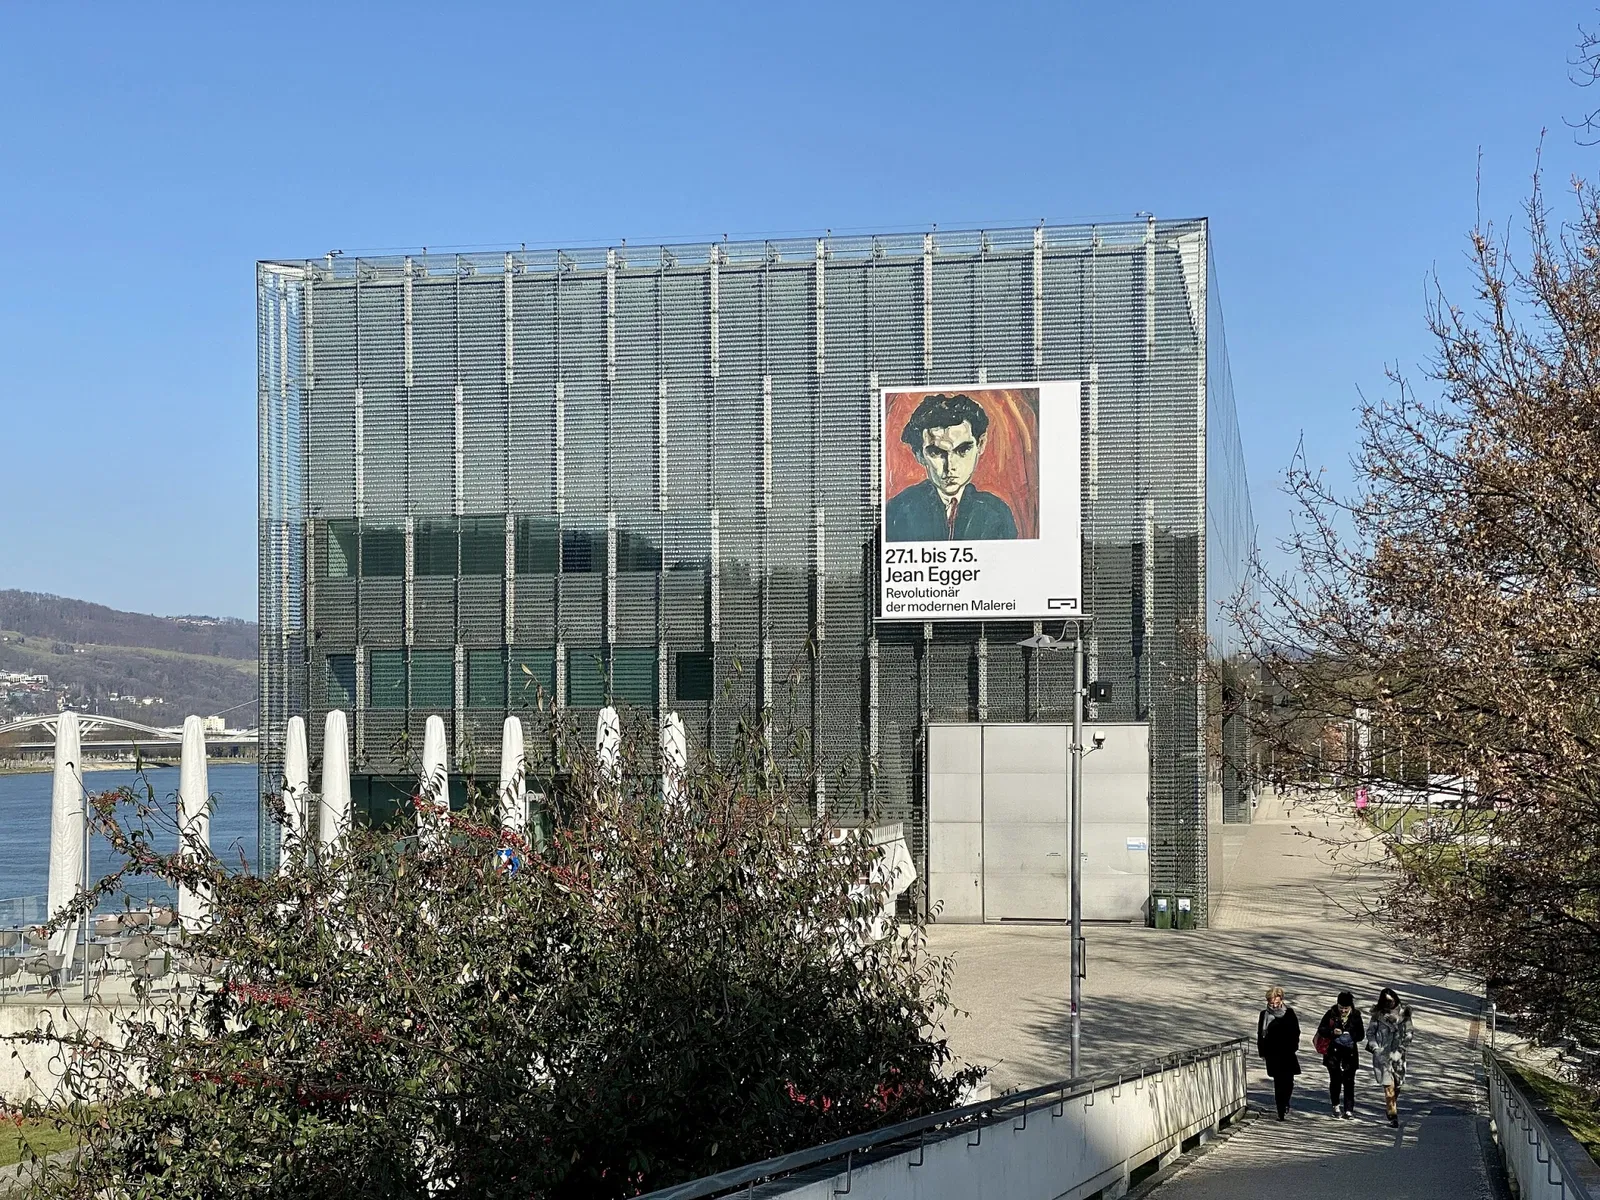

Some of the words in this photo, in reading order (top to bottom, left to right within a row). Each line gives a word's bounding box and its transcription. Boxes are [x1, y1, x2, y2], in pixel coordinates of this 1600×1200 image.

[885, 548, 918, 564] 27.1.
[921, 547, 947, 563] bis
[949, 547, 978, 563] 7.5.
[885, 567, 924, 583] Jean
[928, 566, 980, 585] Egger
[886, 587, 961, 599] Revolutionär
[886, 601, 906, 613] der
[907, 602, 969, 612] modernen
[971, 599, 1016, 611] Malerei
